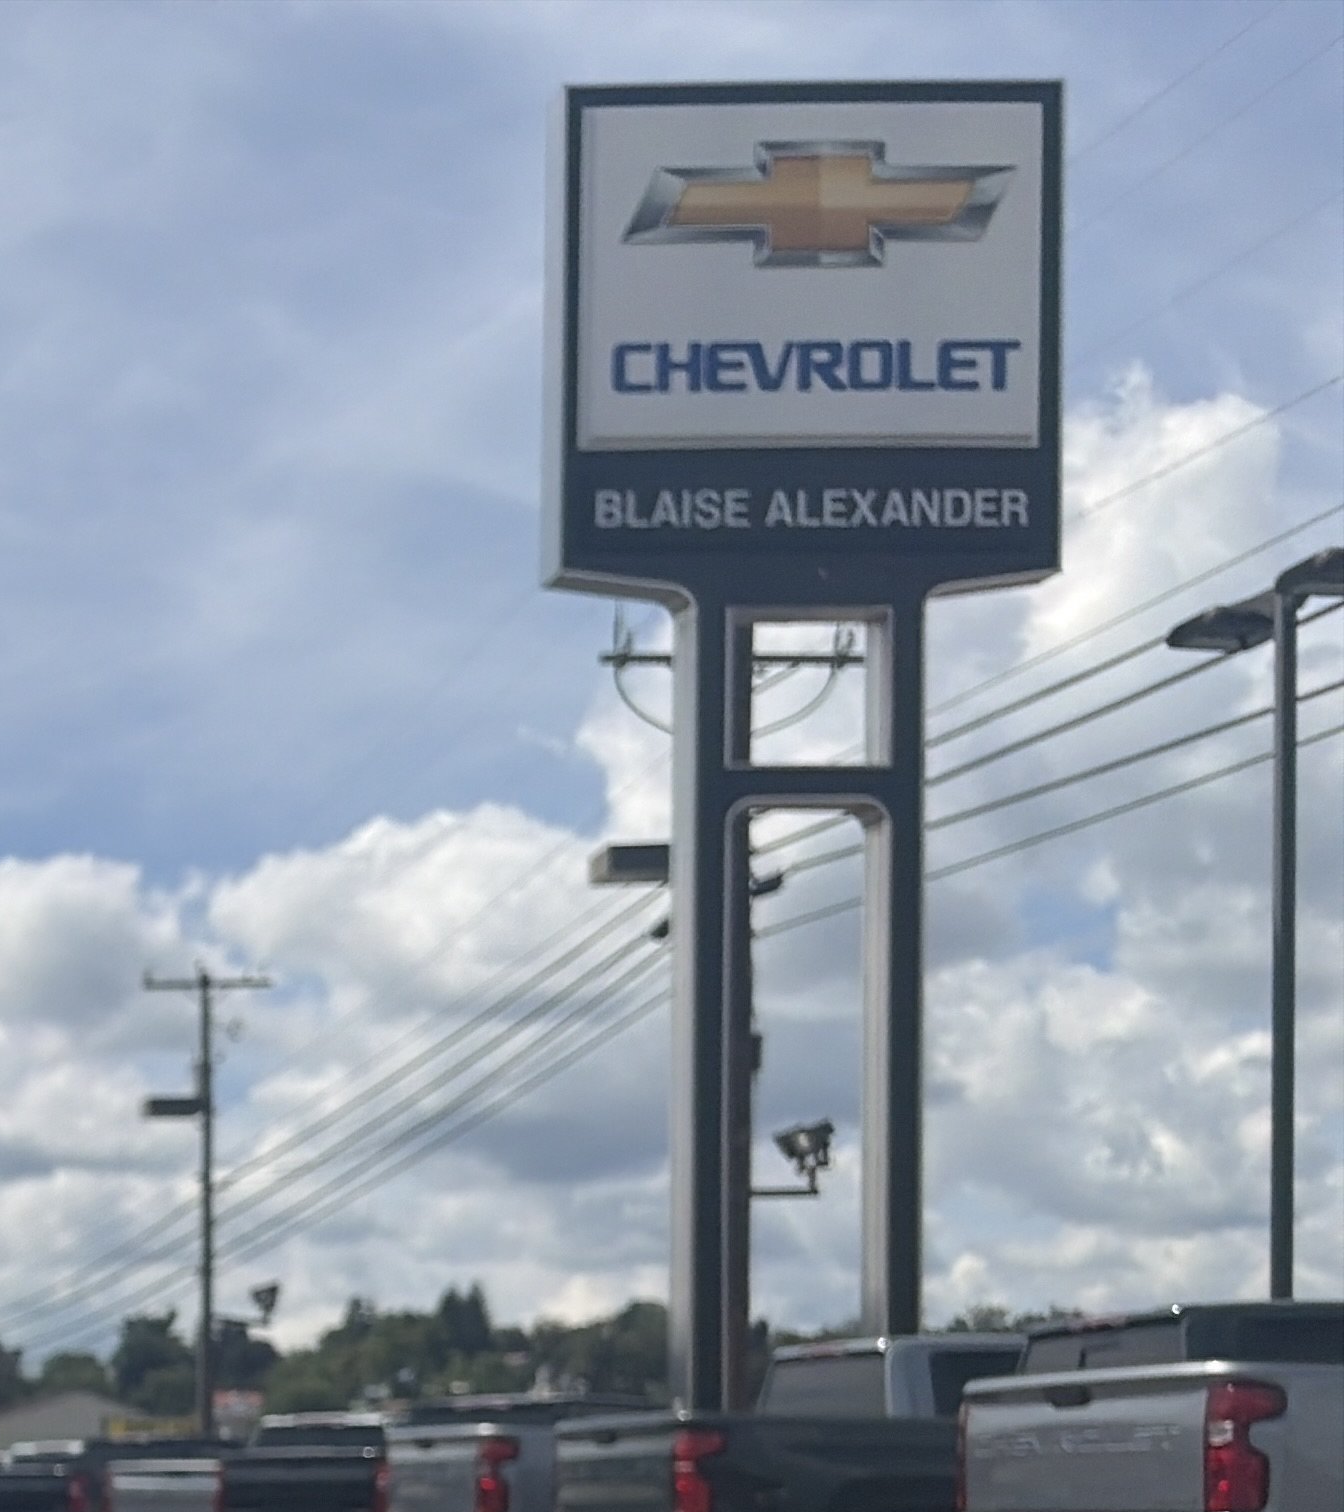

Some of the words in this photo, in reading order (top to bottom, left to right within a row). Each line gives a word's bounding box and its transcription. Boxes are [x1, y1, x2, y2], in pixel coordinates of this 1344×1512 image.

[613, 340, 1021, 392] CHEVROLET
[594, 488, 752, 529] BLAISE
[764, 488, 1030, 528] ALEXANDER
